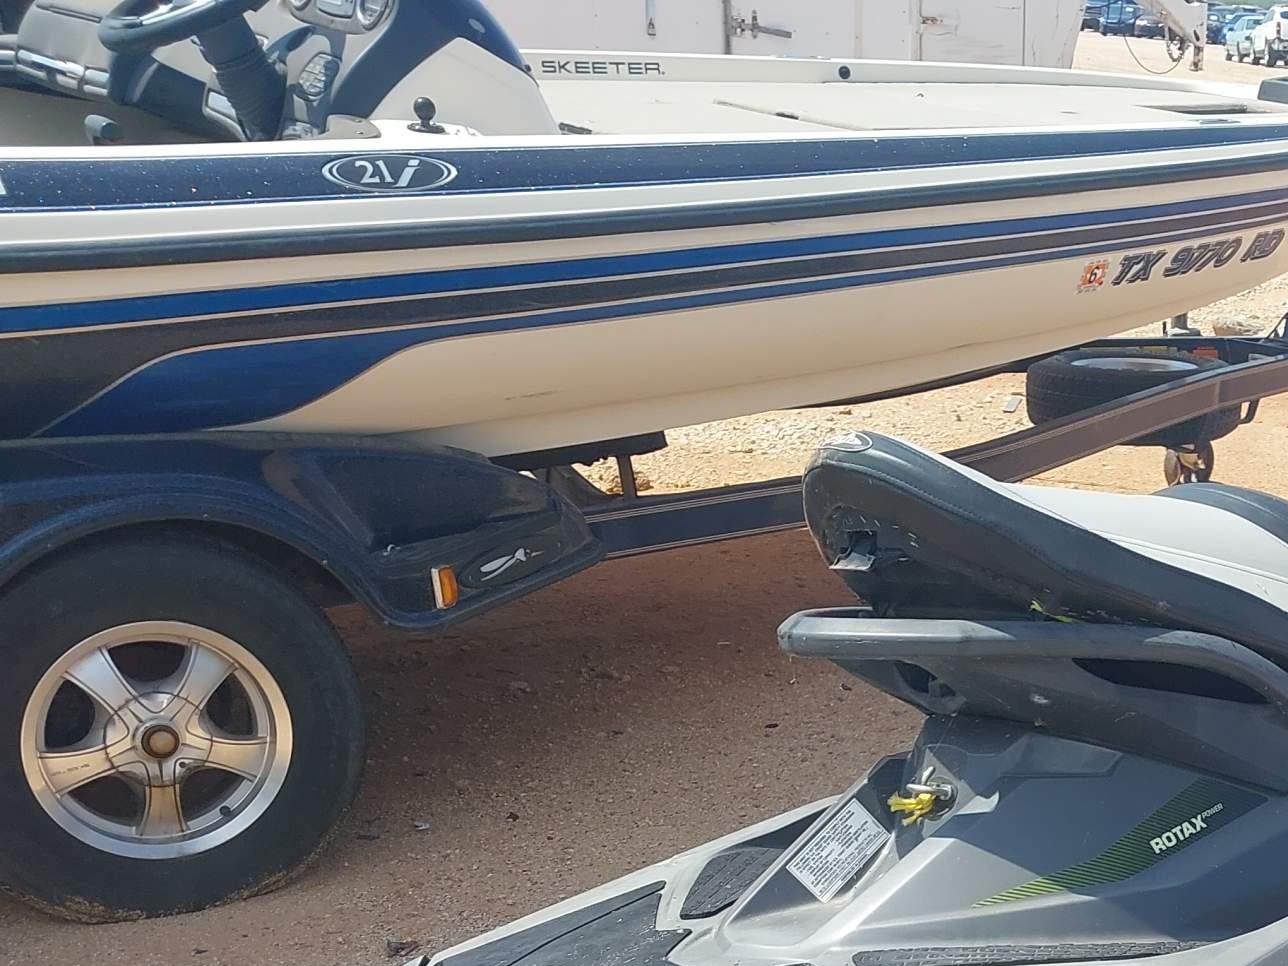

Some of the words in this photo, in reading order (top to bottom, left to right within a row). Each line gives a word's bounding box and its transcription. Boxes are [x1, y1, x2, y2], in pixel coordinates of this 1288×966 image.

[1111, 250, 1167, 286] TX
[1162, 236, 1243, 278] 9770
[1149, 814, 1208, 854] ROTAX
[1201, 802, 1224, 819] POWER
